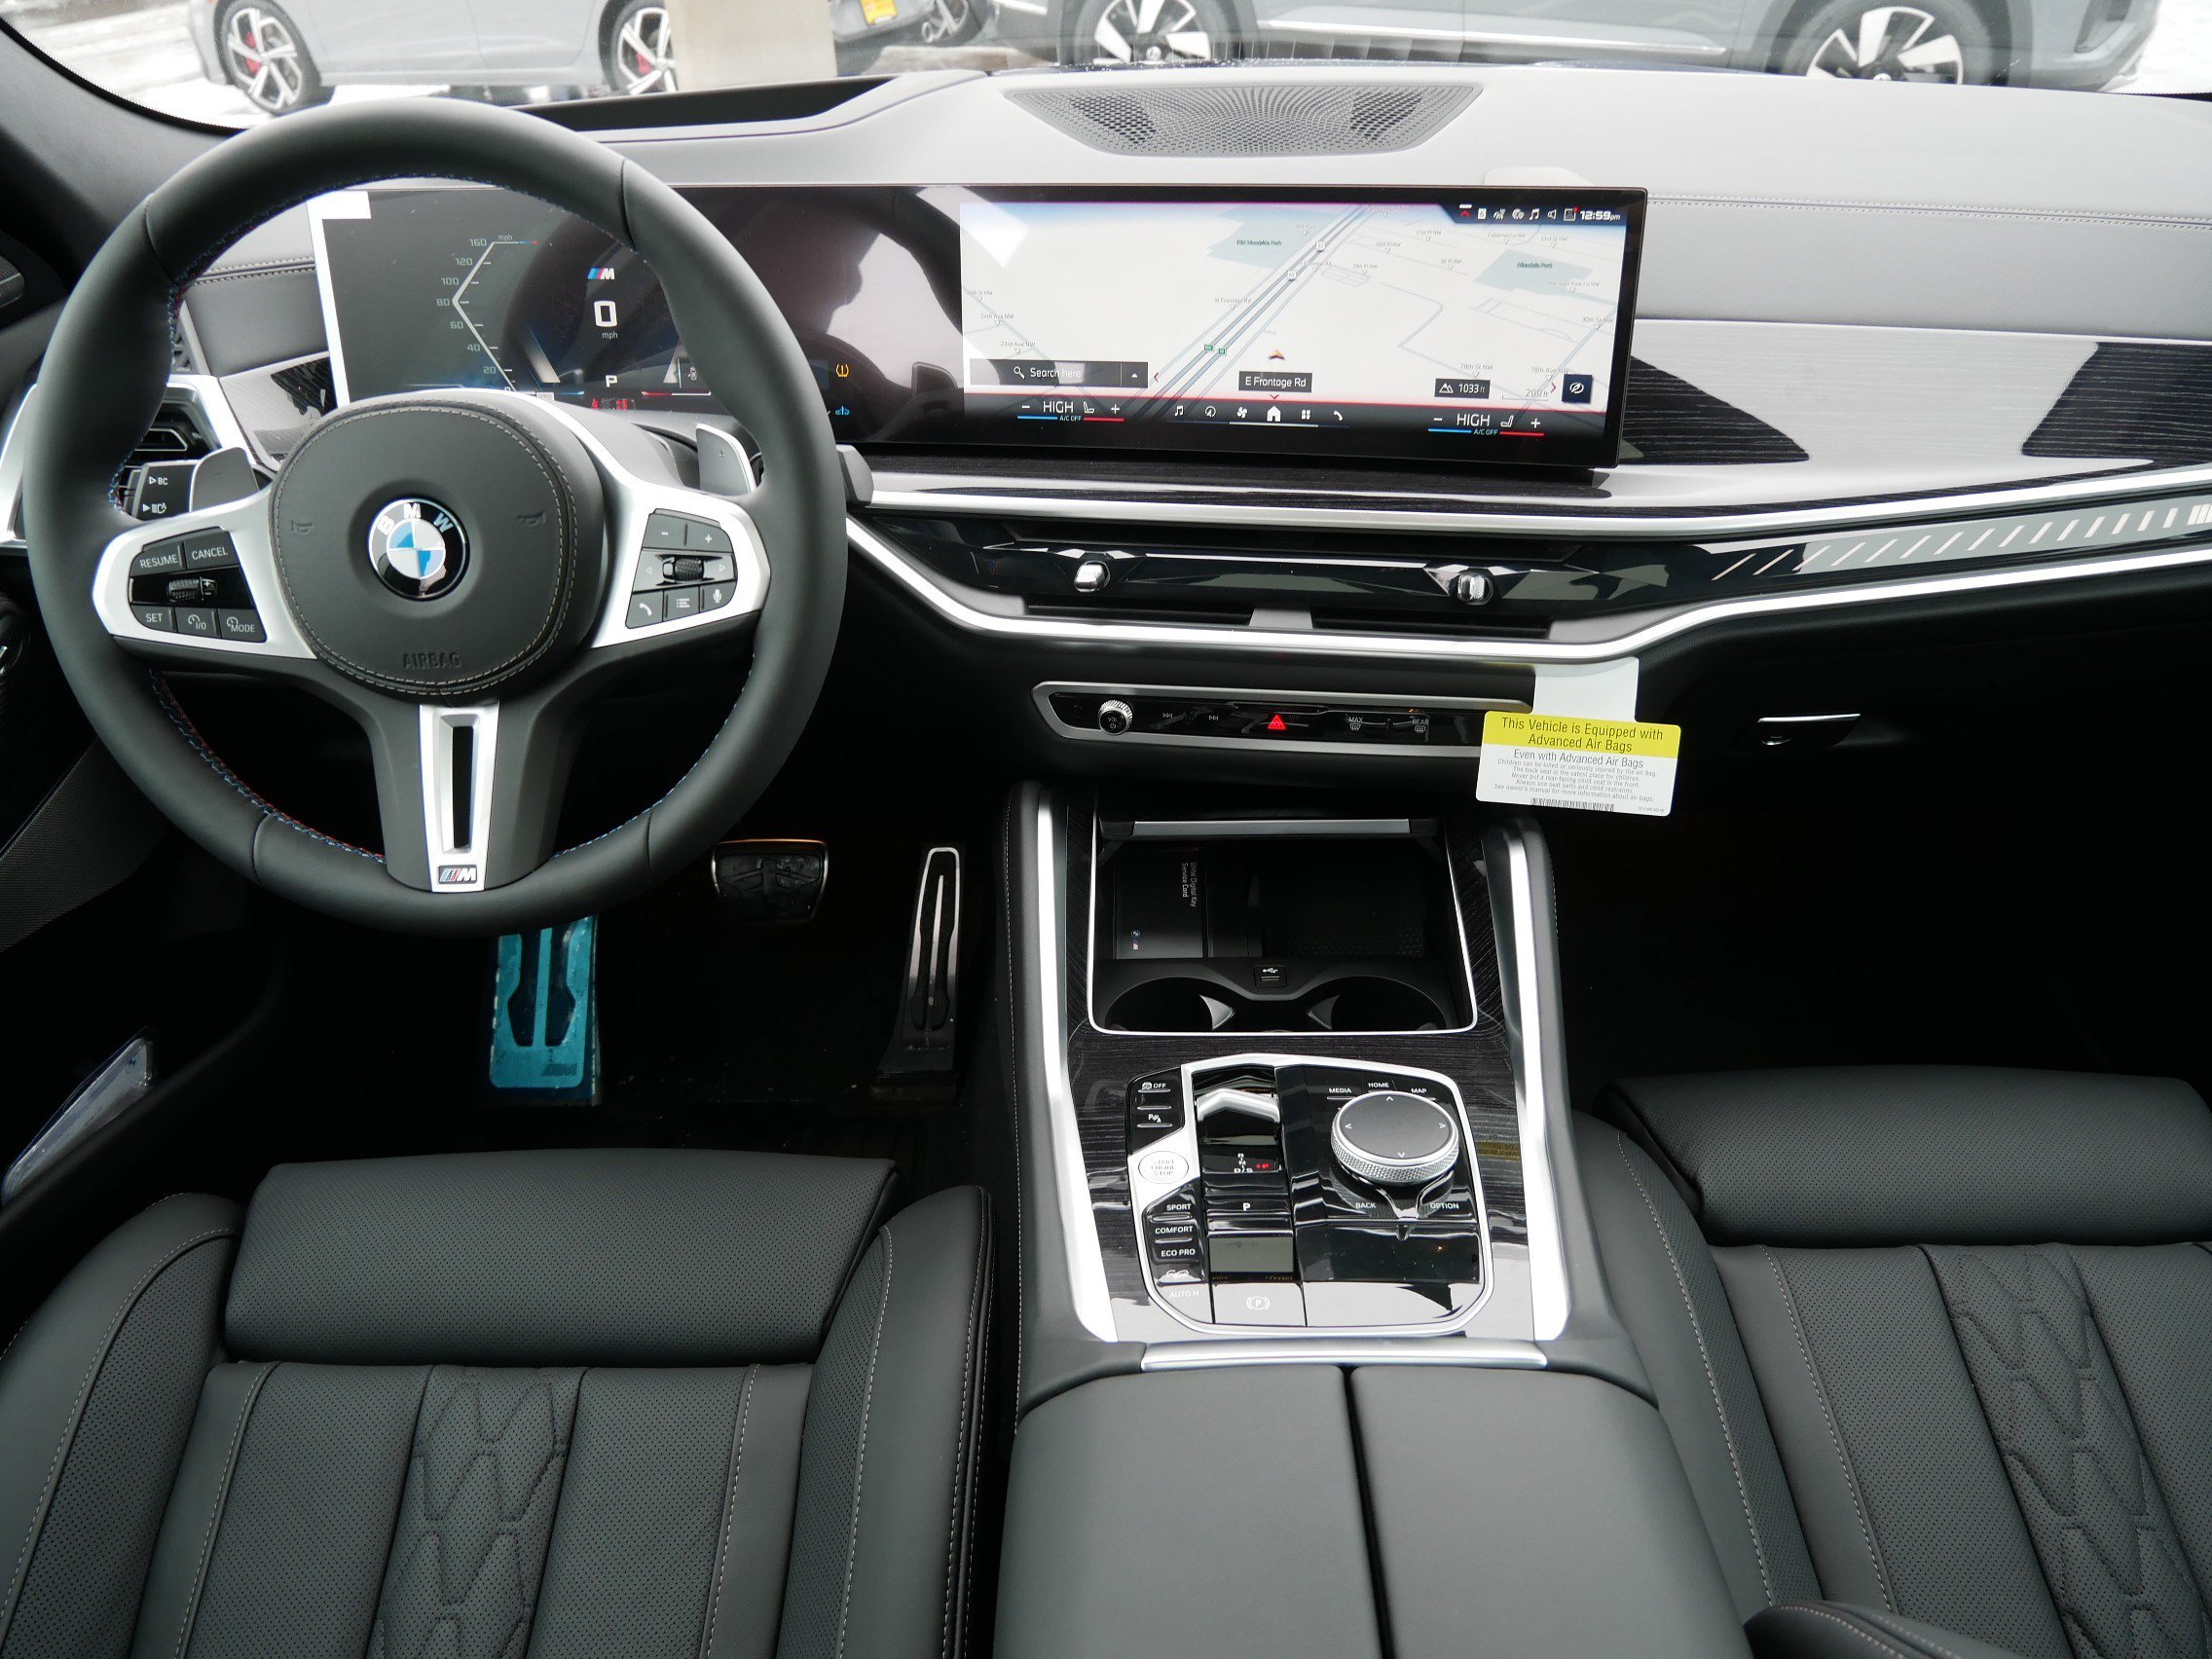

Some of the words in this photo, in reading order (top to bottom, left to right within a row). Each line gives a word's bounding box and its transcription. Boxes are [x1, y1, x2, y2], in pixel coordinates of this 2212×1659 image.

[469, 239, 487, 247] 160
[594, 300, 617, 327] 0
[451, 321, 463, 330] 60
[1030, 367, 1059, 378] Search
[1062, 368, 1082, 378] here
[606, 376, 617, 387] P
[1246, 377, 1252, 386] E
[1254, 377, 1292, 388] Frontage
[1295, 378, 1306, 387] Rd
[1458, 384, 1479, 393] 1033
[1043, 401, 1073, 413] HIGH
[1457, 414, 1490, 426] HIGH
[158, 477, 168, 486] BC
[377, 502, 455, 535] BMW
[192, 547, 228, 560] CANCEL
[140, 555, 178, 569] RESUME
[146, 613, 163, 622] SET
[231, 624, 255, 633] MODE
[403, 652, 461, 671] AIRBAG
[1502, 718, 1525, 730] This
[1529, 719, 1567, 733] Vehicle
[1571, 722, 1581, 734] is
[1585, 723, 1636, 739] Equipped
[1641, 728, 1663, 740] with
[1529, 734, 1582, 749] Advanced
[1586, 738, 1602, 750] Air
[1606, 740, 1633, 754] Bags
[1514, 749, 1535, 759] Even
[1538, 752, 1557, 761] with
[1560, 753, 1604, 765] Advanced
[1606, 756, 1619, 765] Air
[1621, 757, 1643, 769] Bags
[1156, 1226, 1193, 1235] COMFORT
